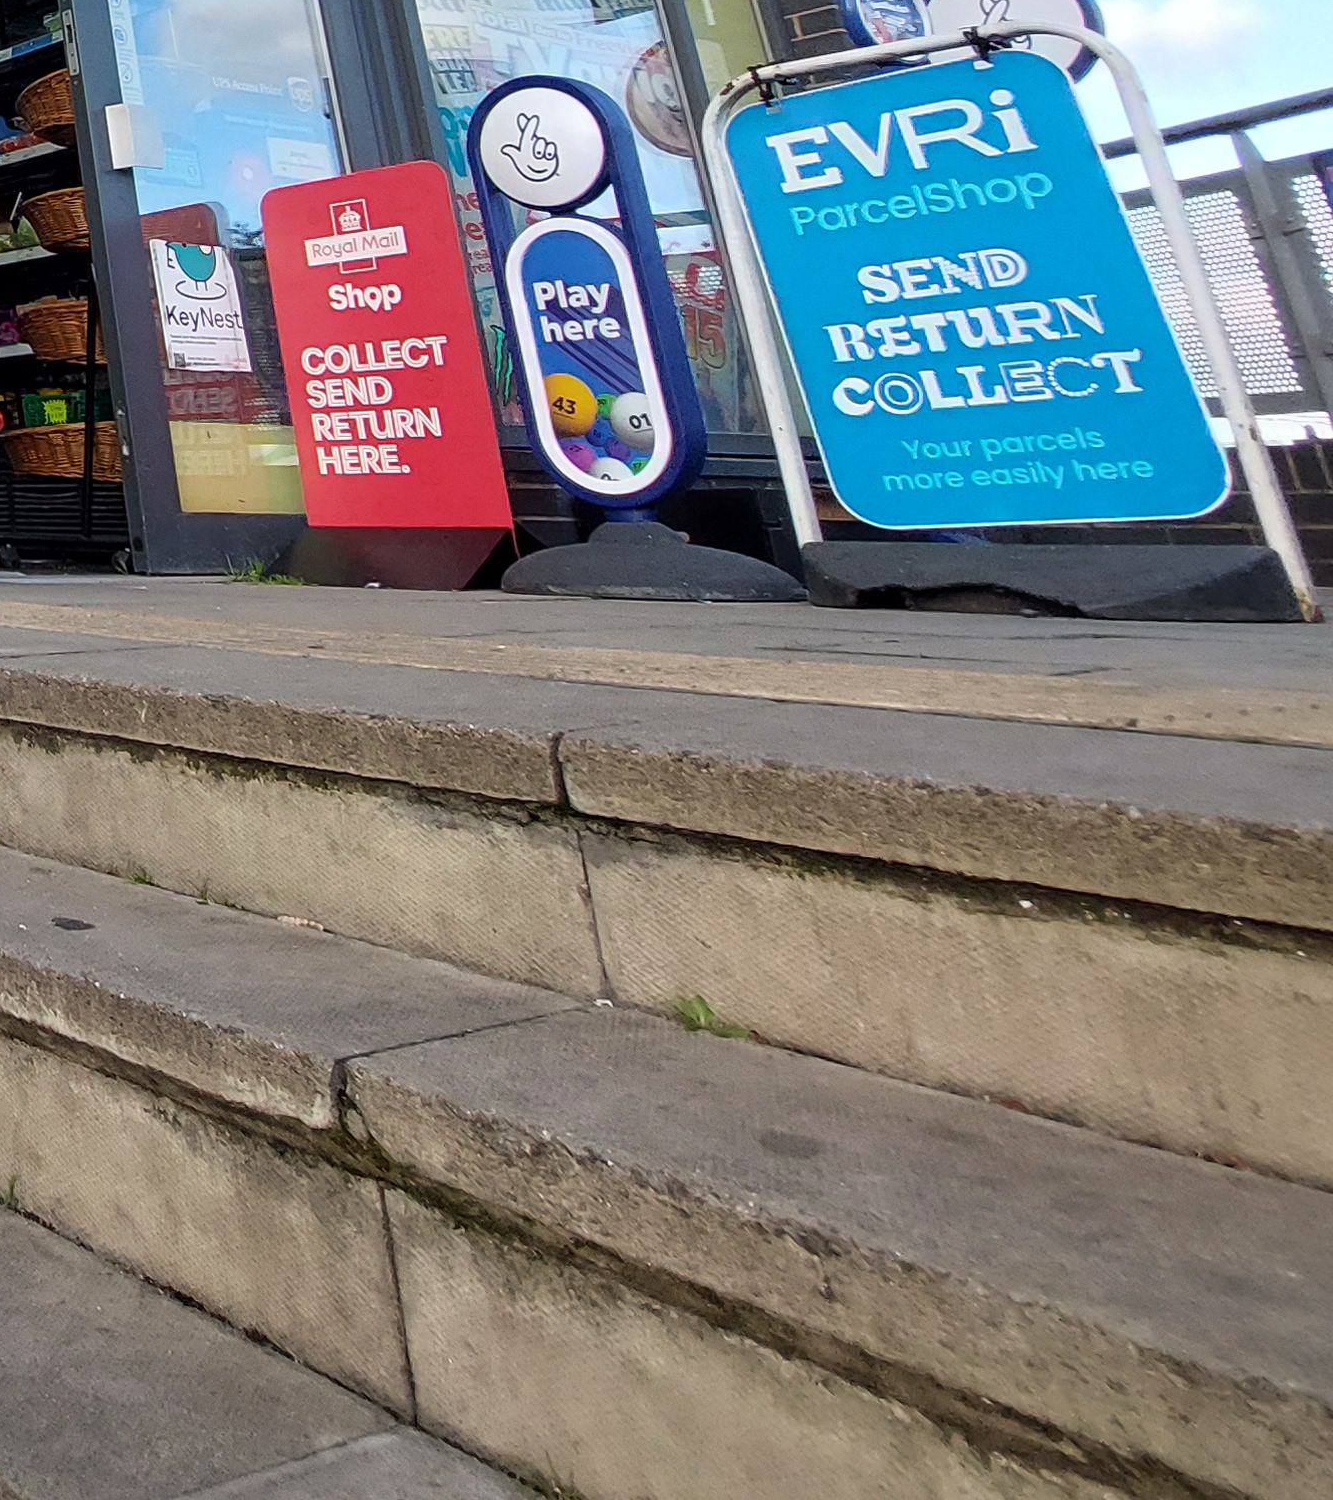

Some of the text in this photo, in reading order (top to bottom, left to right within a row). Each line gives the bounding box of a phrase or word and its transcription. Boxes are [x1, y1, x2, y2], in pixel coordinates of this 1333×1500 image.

[789, 169, 1054, 237] ParcelShop
[311, 231, 400, 259] Royal Mail
[857, 247, 1029, 304] SEND
[328, 283, 402, 312] Shop
[533, 280, 611, 315] Play
[165, 305, 244, 333] KeyNest
[540, 315, 621, 343] here
[823, 294, 1107, 363] RETURN
[300, 335, 448, 375] COLLECT
[306, 374, 393, 409] SEND
[831, 348, 1144, 417] COLLECT
[552, 396, 577, 415] 43
[628, 412, 653, 430] 01
[312, 406, 442, 443] RETURN
[318, 443, 412, 476] HERE.
[901, 426, 1105, 463] Your parcels
[882, 457, 1155, 492] more easily here
